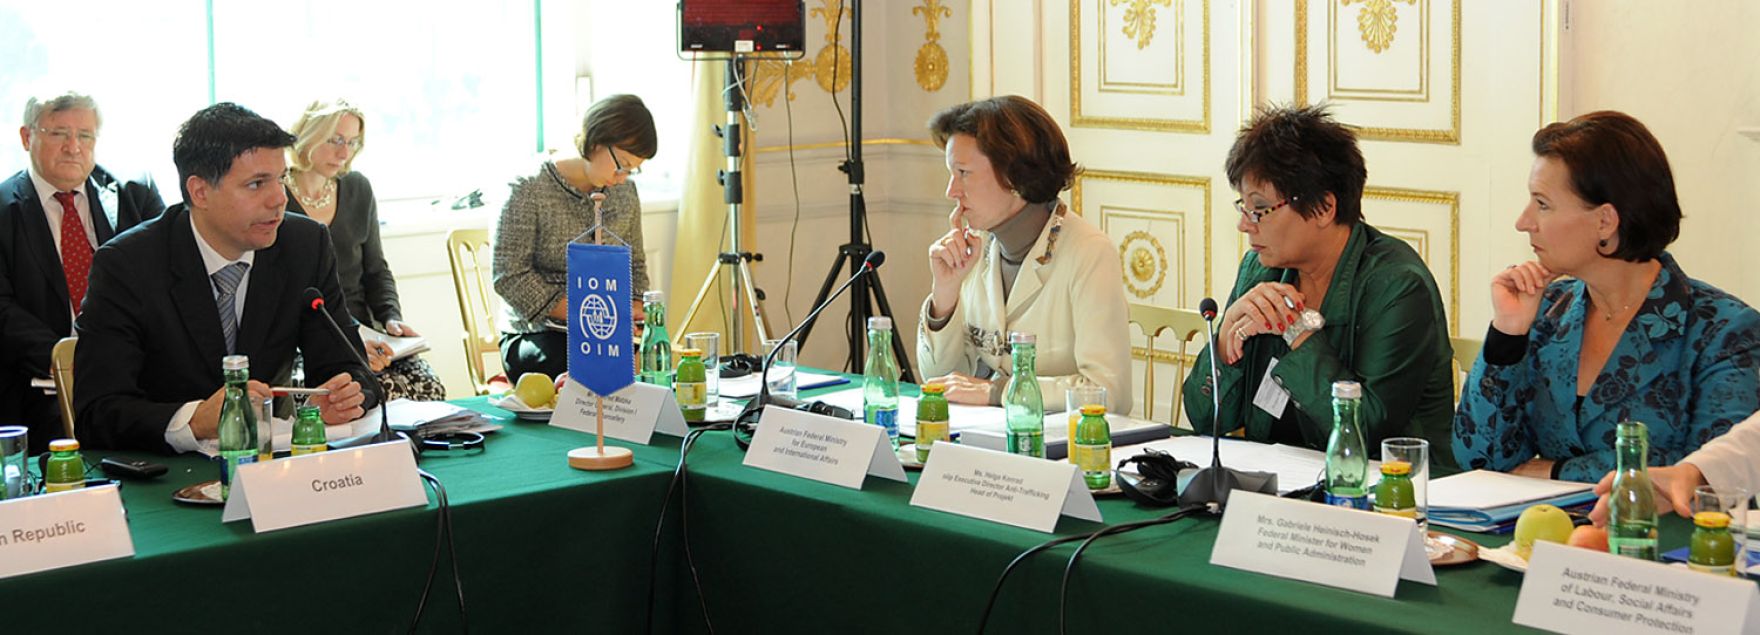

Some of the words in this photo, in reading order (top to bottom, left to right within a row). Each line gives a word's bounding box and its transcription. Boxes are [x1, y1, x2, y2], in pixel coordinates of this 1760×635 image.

[577, 276, 617, 291] IOM
[581, 341, 620, 357] OIM
[580, 407, 597, 417] Federa
[779, 426, 802, 437] Austrian
[803, 430, 824, 441] Federal
[825, 434, 848, 447] Ministry
[791, 438, 800, 446] for
[800, 440, 827, 452] European
[773, 446, 785, 454] and
[785, 448, 820, 461] International
[819, 454, 839, 466] Affairs
[311, 474, 363, 492] Croatia
[954, 474, 981, 486] Executive
[981, 479, 1005, 491] Director
[984, 471, 1001, 481] Helga
[1002, 475, 1024, 485] Konrad
[970, 487, 985, 497] Head
[985, 490, 993, 498] of
[12, 520, 86, 543] Republic
[1257, 514, 1274, 526] Mrs.
[1276, 517, 1312, 532] Gabriele
[1312, 524, 1380, 543] Heinisch-Hosek
[1257, 526, 1289, 540] Federal
[1290, 531, 1324, 547] Minister
[1325, 538, 1338, 549] for
[1339, 541, 1373, 554] Women
[1257, 540, 1274, 551] and
[1274, 542, 1301, 555] Public
[1302, 547, 1366, 567] Administration
[1562, 567, 1608, 586] Austrian
[1610, 576, 1653, 594] Federal
[1655, 585, 1701, 607] Ministry
[1560, 583, 1573, 593] of
[1575, 585, 1615, 602] Labour,
[1618, 593, 1653, 611] Social
[1655, 602, 1694, 619] Affairs
[1553, 597, 1574, 610] and
[1575, 600, 1633, 622] Consumer
[1634, 613, 1694, 635] Protection
